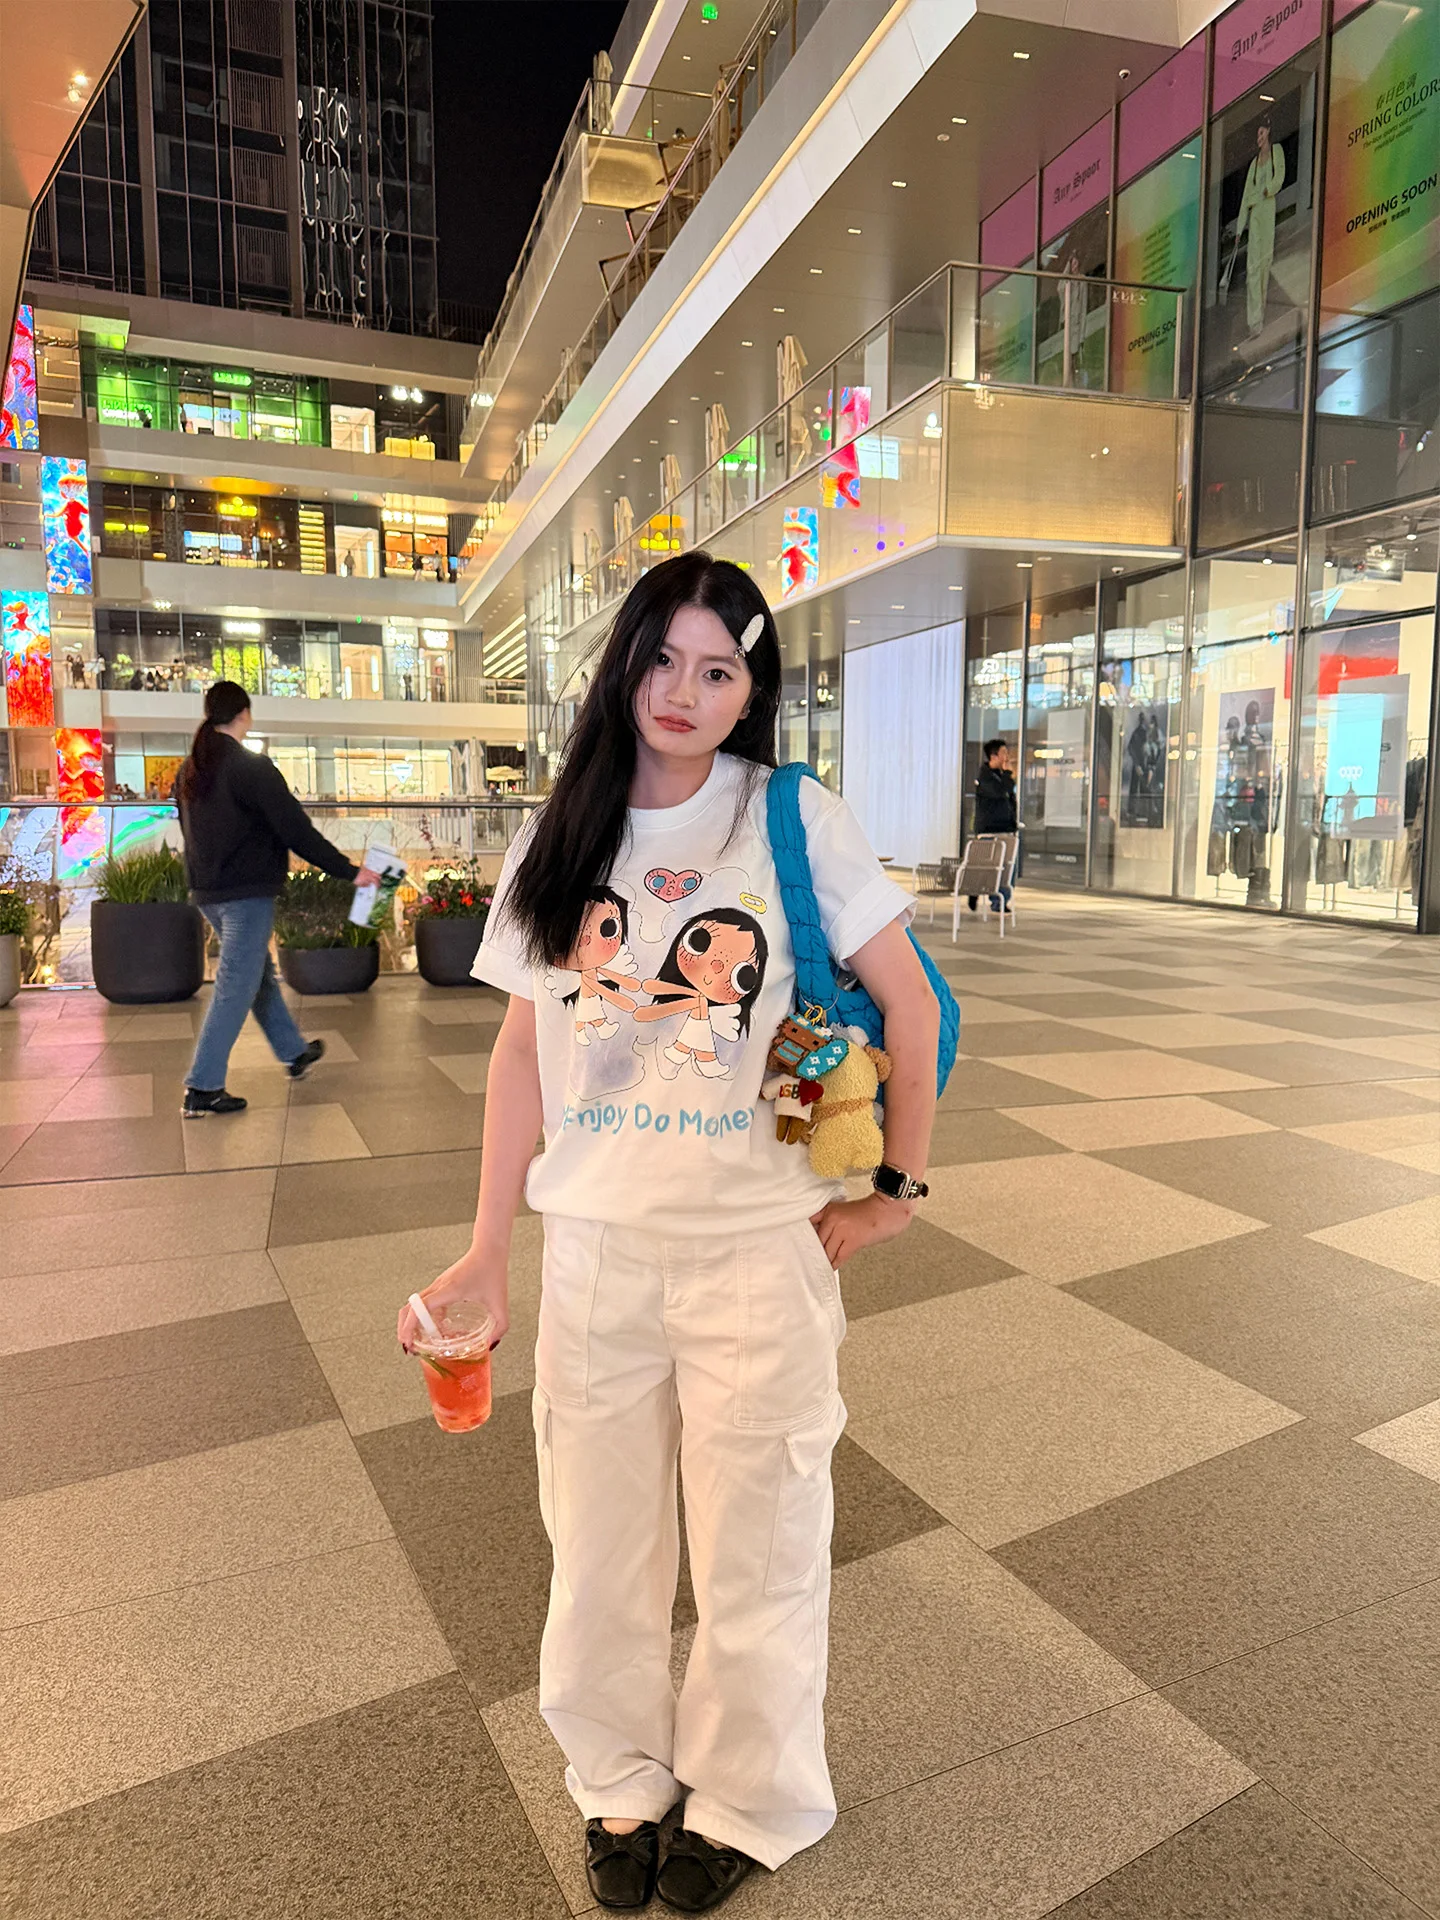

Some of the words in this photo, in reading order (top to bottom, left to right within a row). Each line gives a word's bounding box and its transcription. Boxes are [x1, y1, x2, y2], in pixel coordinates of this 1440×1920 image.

[1347, 107, 1392, 148] SPRING
[1346, 194, 1398, 234] OPENING
[1401, 173, 1438, 204] SOON
[1128, 326, 1161, 352] OPENING
[634, 1102, 670, 1133] Do
